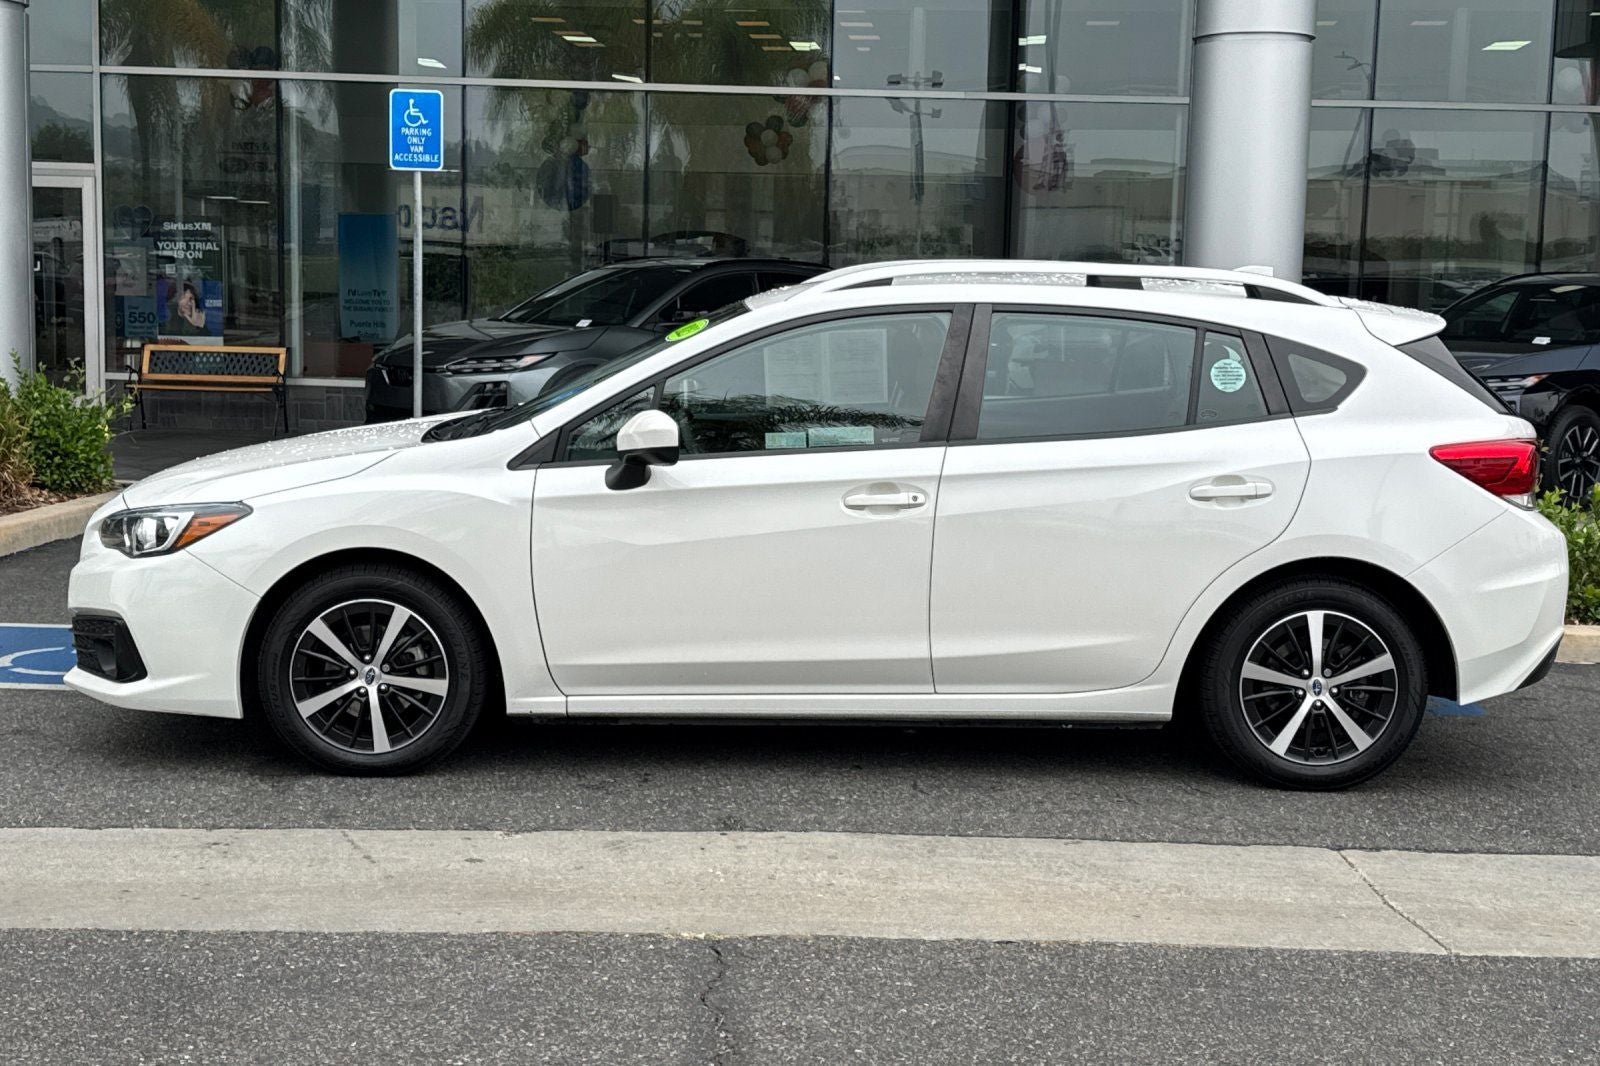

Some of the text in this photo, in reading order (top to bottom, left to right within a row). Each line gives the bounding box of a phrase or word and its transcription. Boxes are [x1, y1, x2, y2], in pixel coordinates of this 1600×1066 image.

[401, 127, 432, 136] PARKING
[407, 136, 425, 145] ONLY
[410, 145, 424, 153] VAN
[394, 153, 439, 162] ACCESSIBLE
[163, 222, 212, 231] SiriusXM
[157, 241, 220, 251] YOUR TRIAL
[174, 251, 203, 259] IS ON
